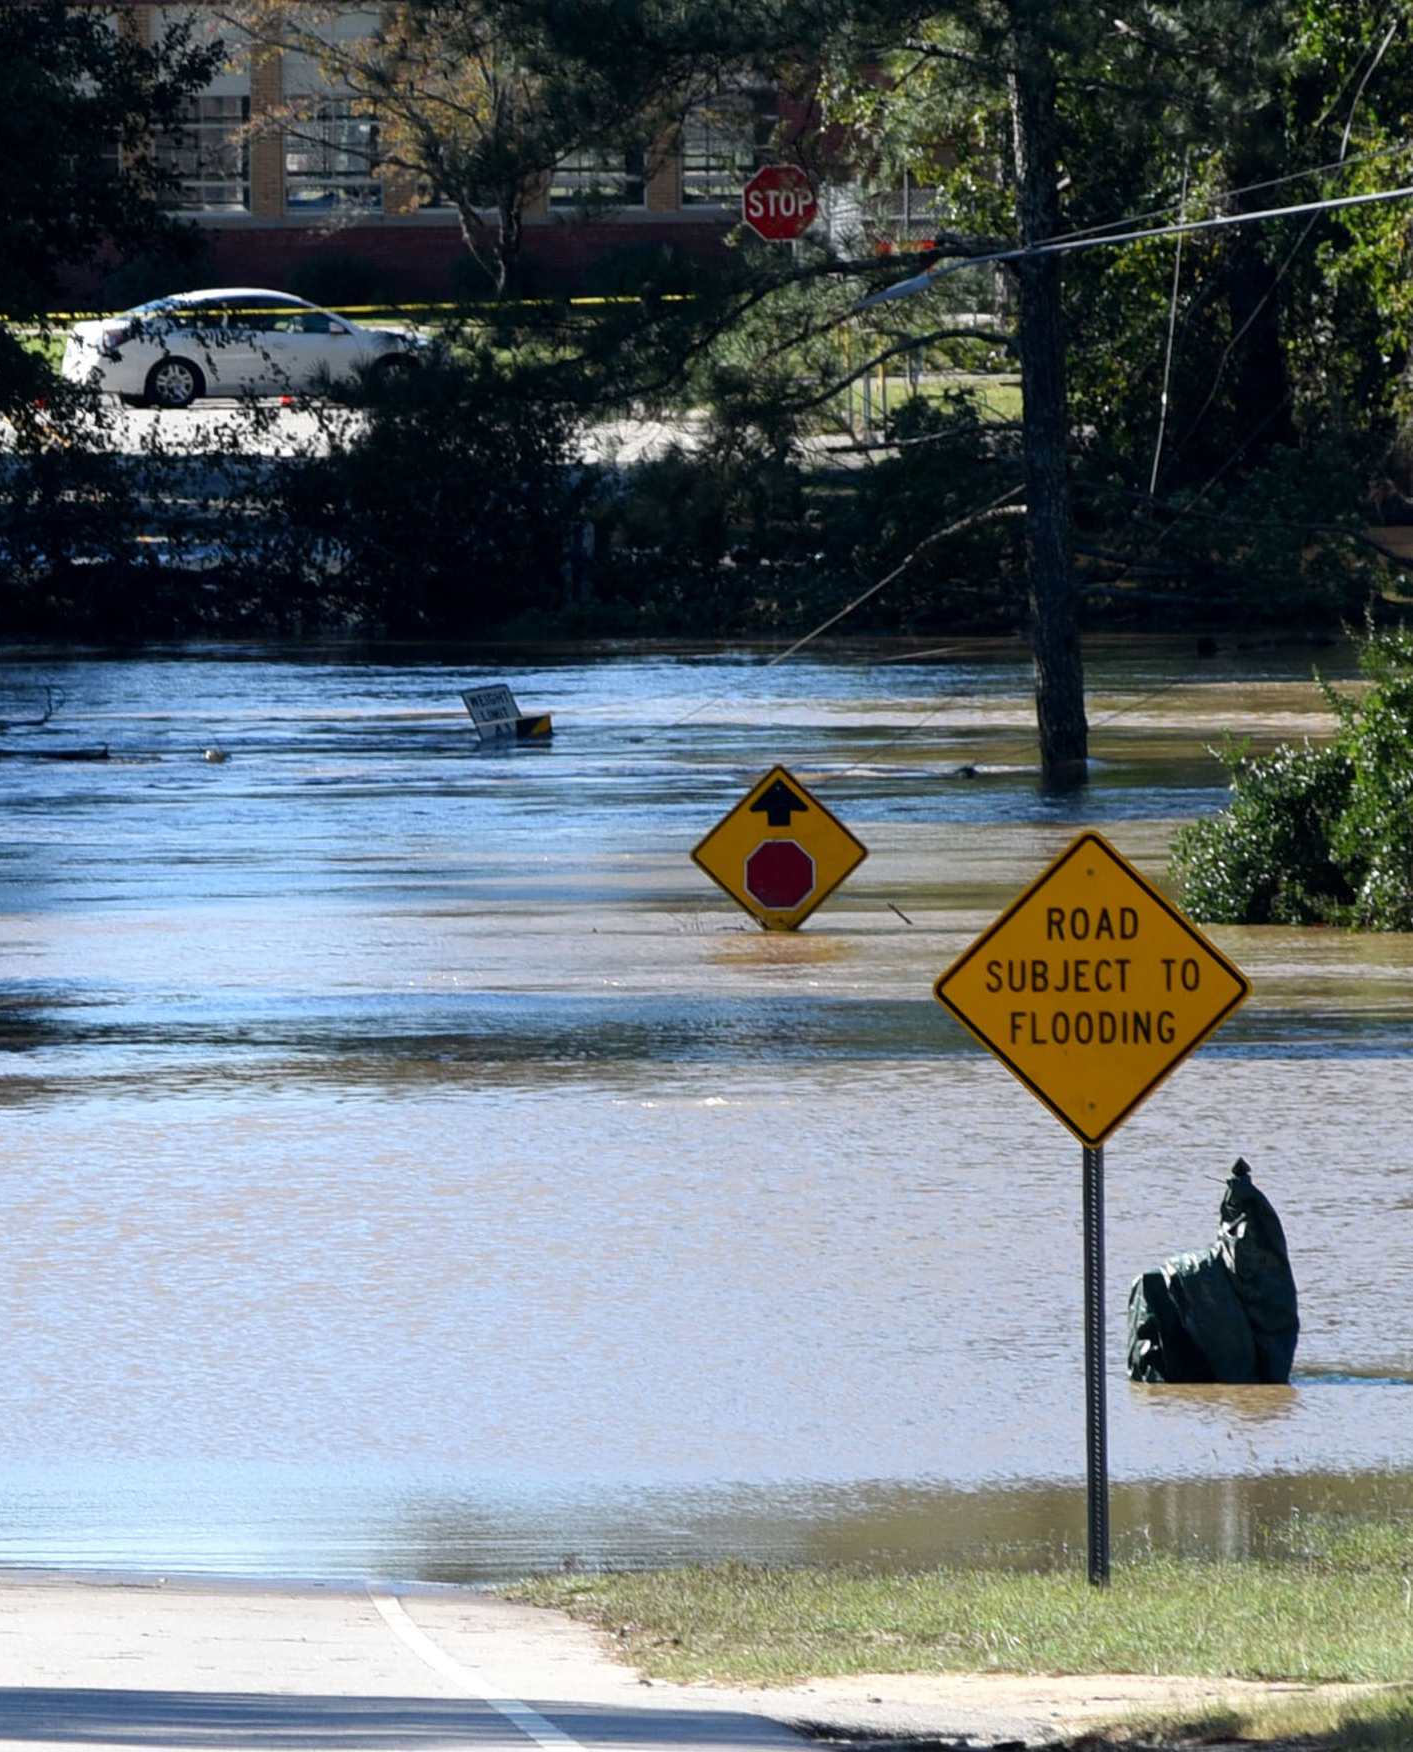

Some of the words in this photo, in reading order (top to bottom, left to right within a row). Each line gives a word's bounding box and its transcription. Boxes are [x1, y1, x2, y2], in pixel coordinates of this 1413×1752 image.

[748, 189, 813, 218] STOP
[468, 690, 509, 708] WEIGHT
[1046, 907, 1139, 941] ROAD
[985, 959, 1131, 993] SUBJECT
[1161, 958, 1200, 992] TO
[1010, 1011, 1176, 1045] FLOODING
